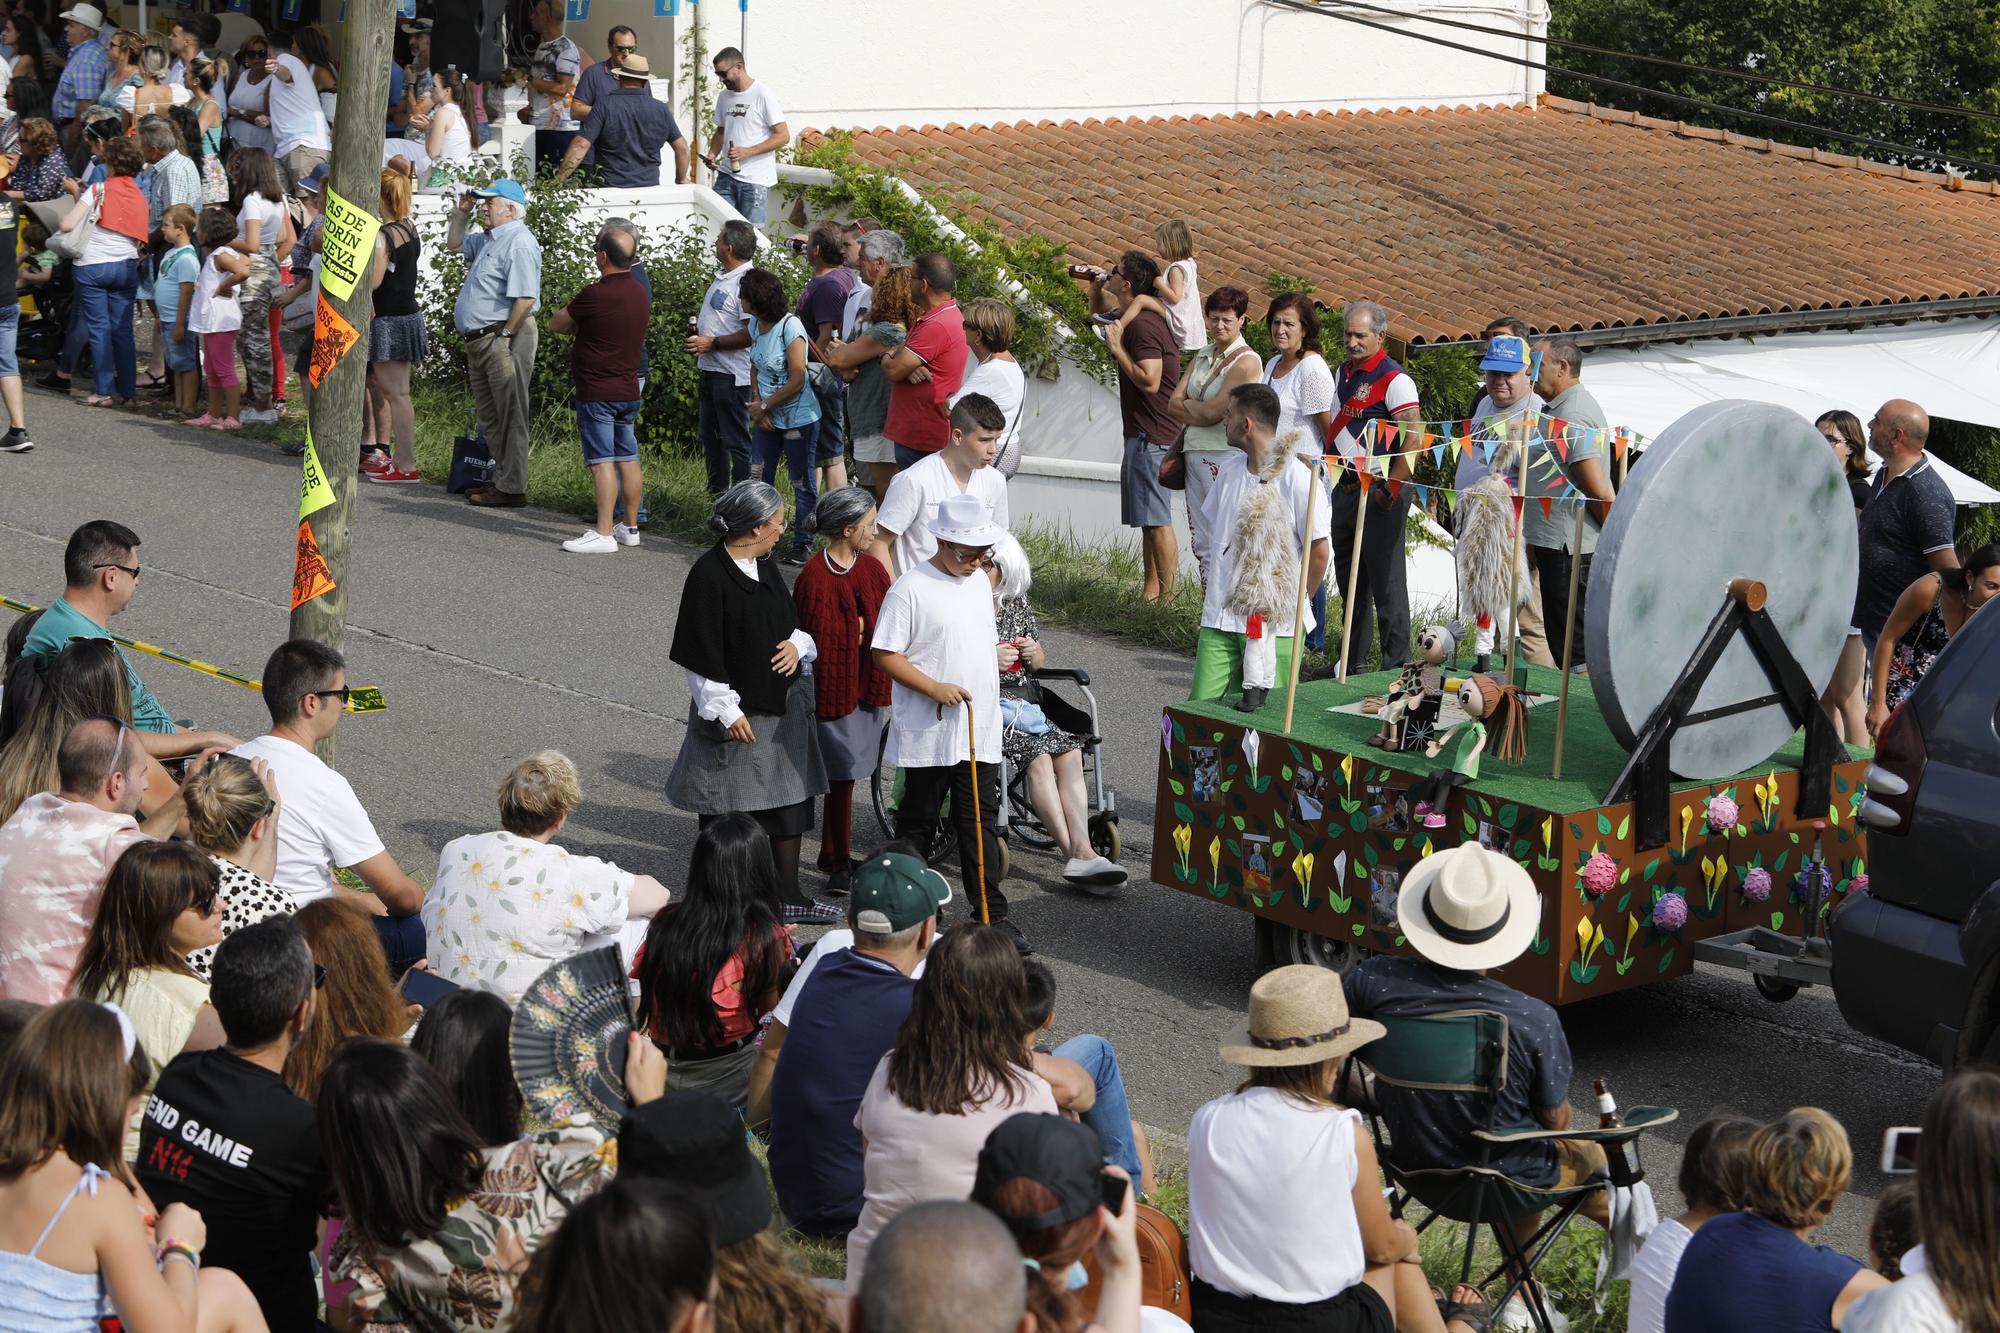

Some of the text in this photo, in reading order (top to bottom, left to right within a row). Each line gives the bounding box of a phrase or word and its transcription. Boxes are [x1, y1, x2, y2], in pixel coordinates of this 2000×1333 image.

[325, 216, 362, 250] EDRÍN
[342, 211, 367, 232] DE
[325, 258, 355, 282] Agosto
[1341, 404, 1364, 418] TEAM
[464, 456, 488, 467] FUENS
[307, 464, 321, 489] DE
[146, 1093, 253, 1168] END GAME
